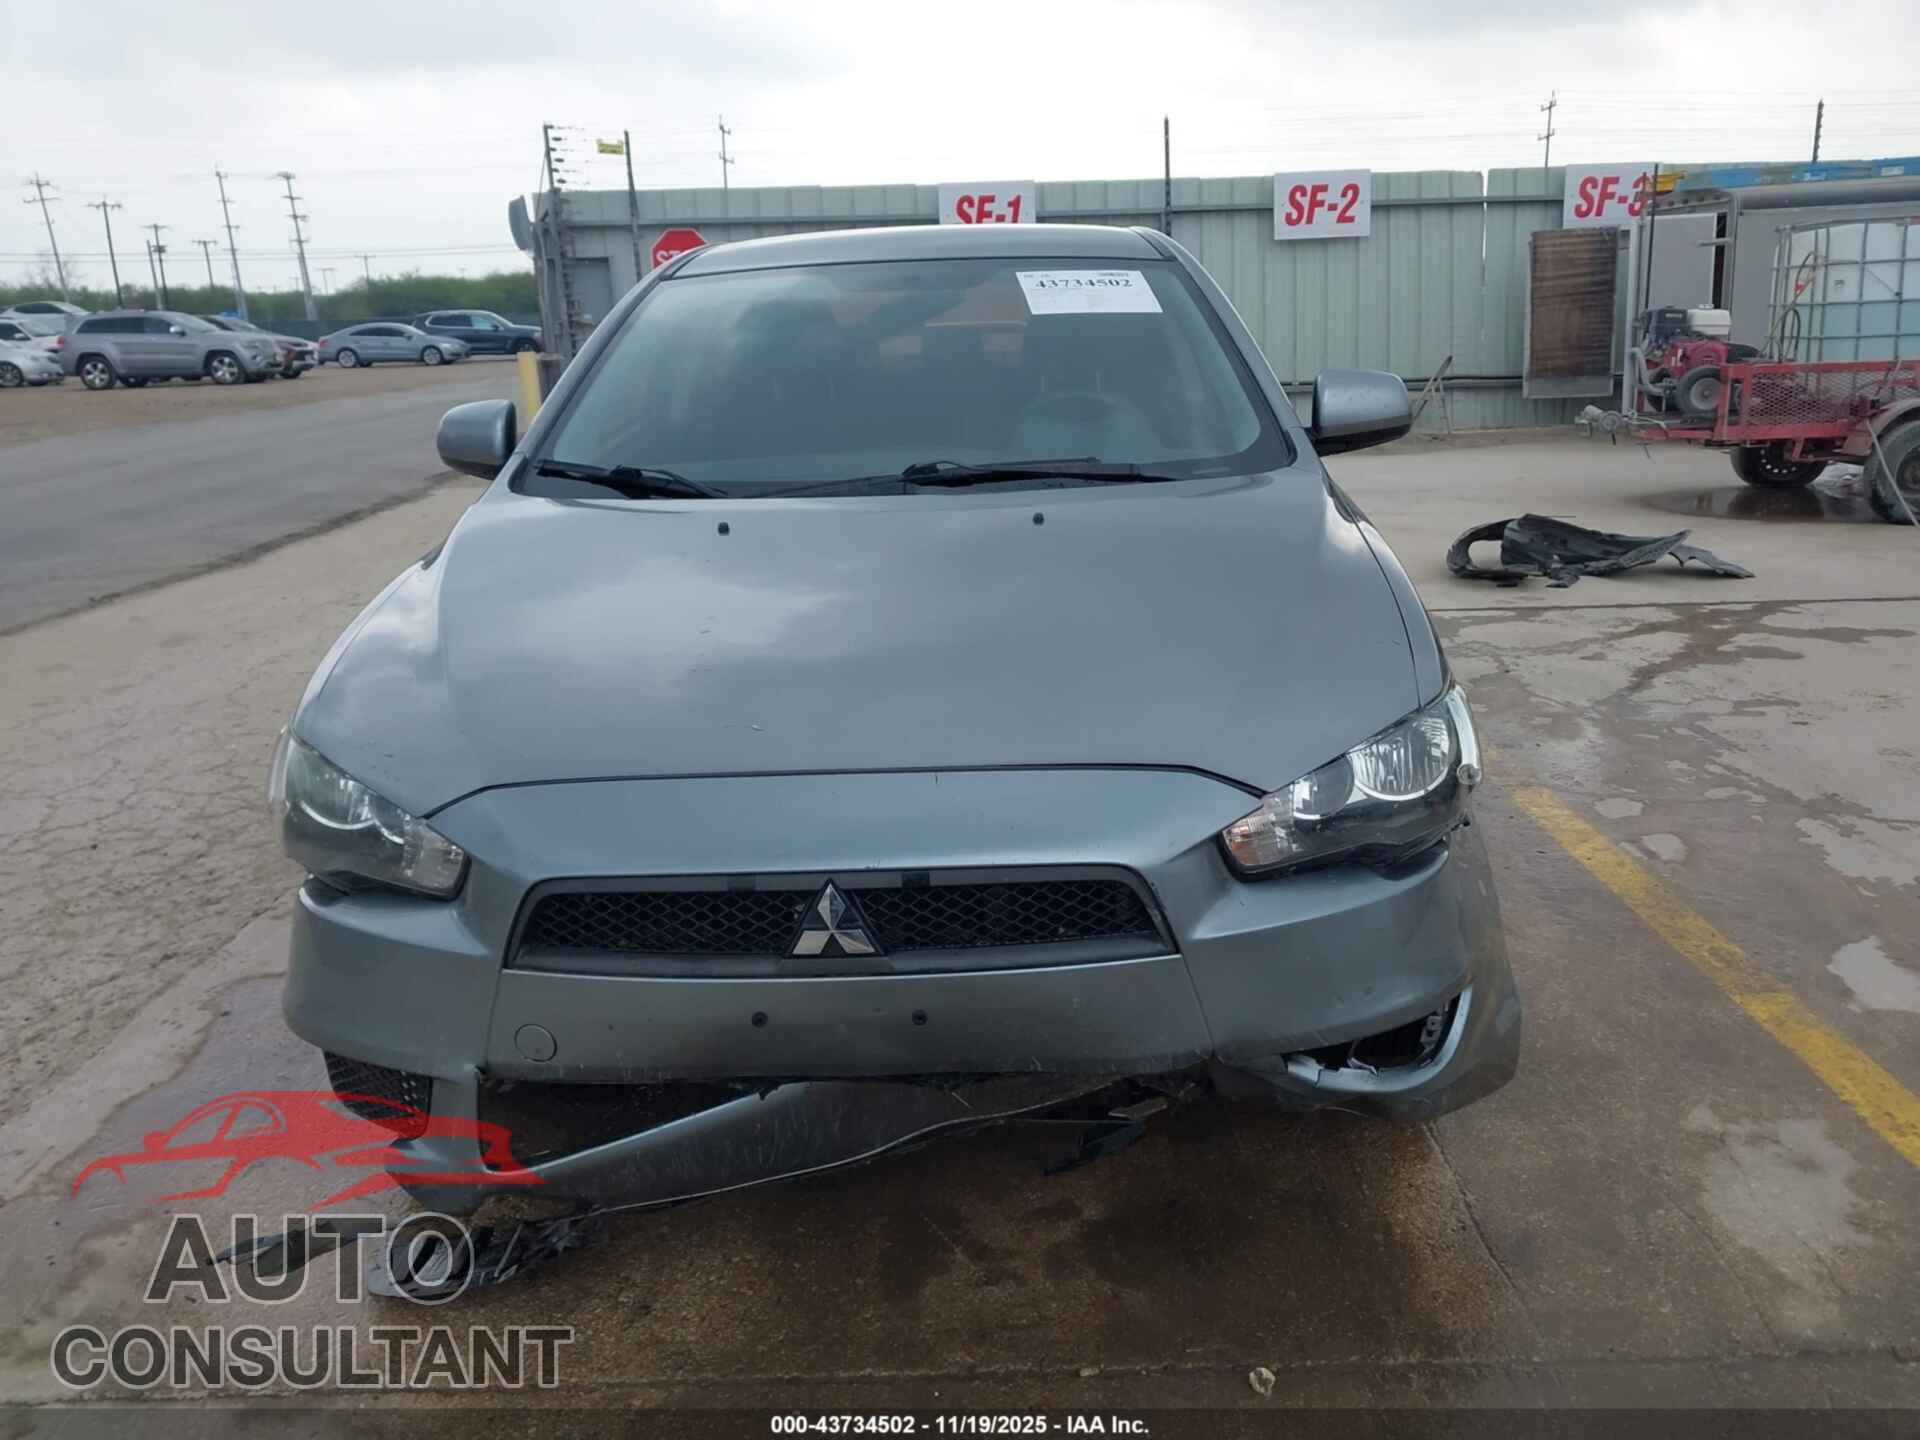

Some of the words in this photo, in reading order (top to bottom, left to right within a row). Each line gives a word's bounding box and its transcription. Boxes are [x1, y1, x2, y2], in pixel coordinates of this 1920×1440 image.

[956, 194, 1022, 224] SF-1
[1284, 183, 1361, 226] SF-2
[1035, 278, 1134, 289] 43734502
